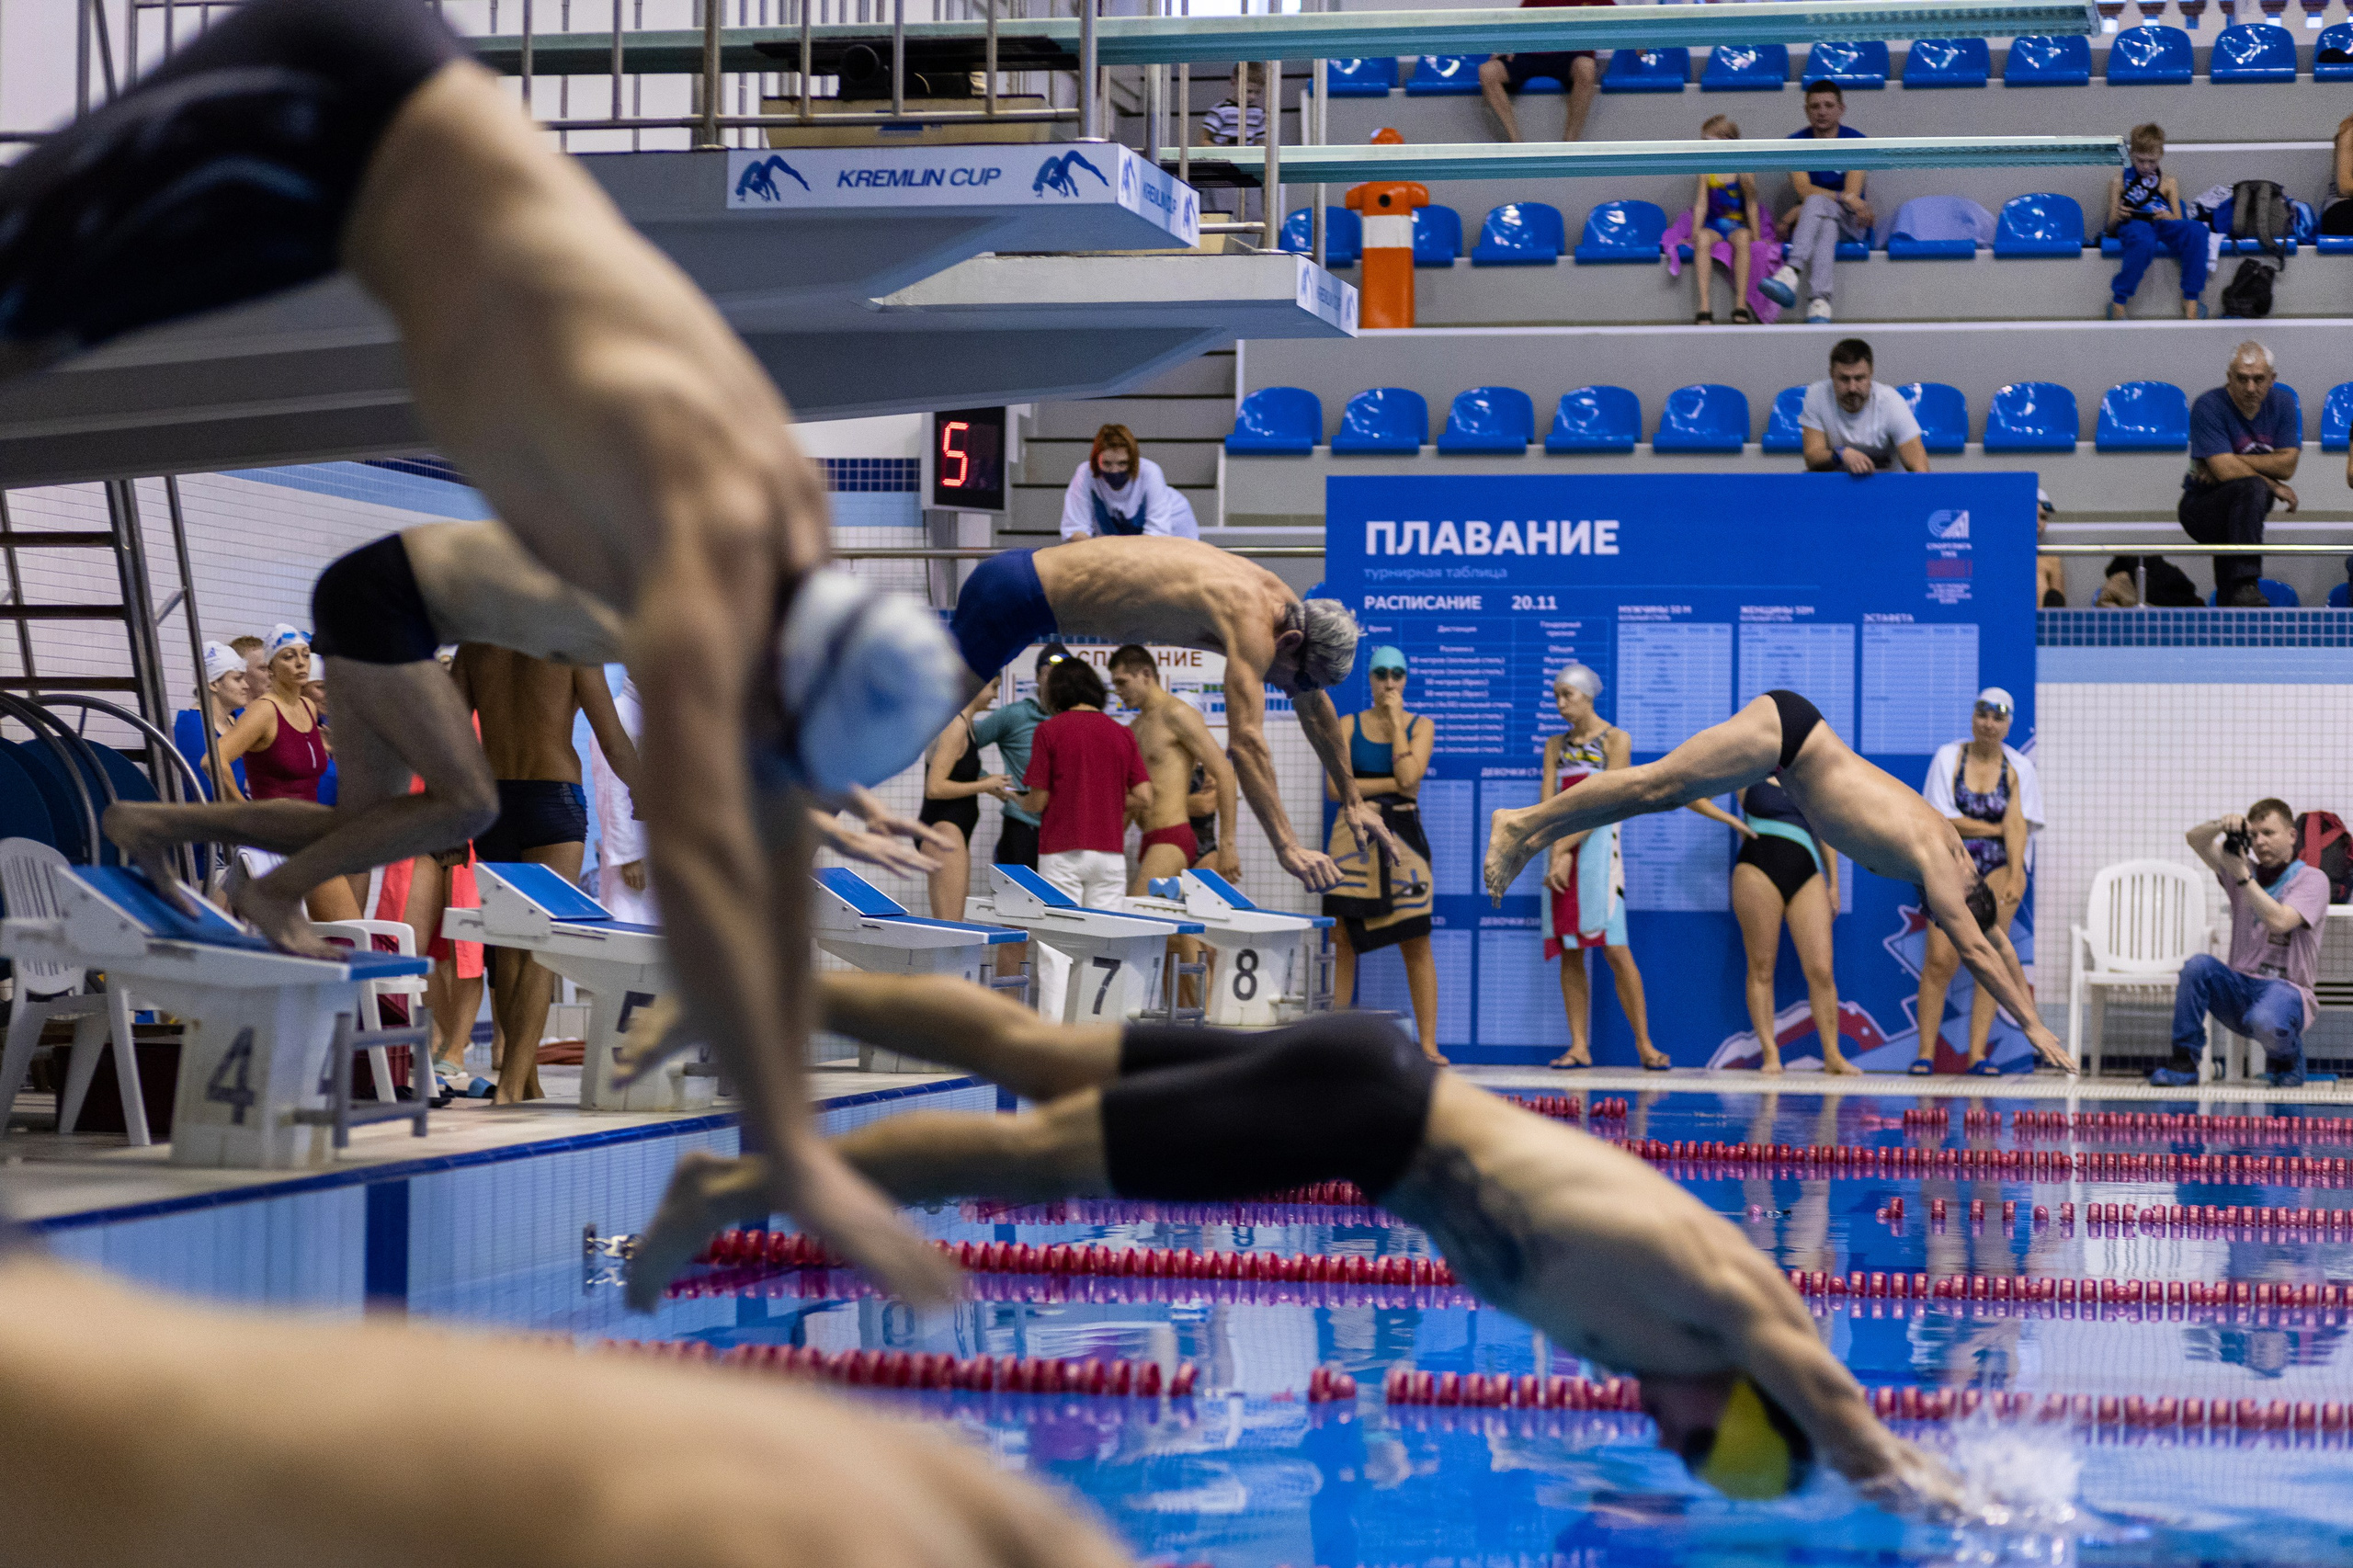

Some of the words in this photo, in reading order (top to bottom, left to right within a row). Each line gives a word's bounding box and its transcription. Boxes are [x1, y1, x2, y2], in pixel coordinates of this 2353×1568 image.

[836, 168, 946, 187] KREMLIN
[949, 167, 1002, 186] CUP
[942, 421, 970, 487] 5
[1365, 520, 1620, 556] ПЛАВАНИЕ
[1364, 568, 1442, 581] турнирная
[1446, 564, 1508, 580] таблица
[1364, 596, 1483, 610] РАСПИСАНИЕ
[1511, 596, 1558, 610] 20.11
[1092, 956, 1121, 1015] 7
[1233, 949, 1259, 1001] 8
[206, 1027, 256, 1126] 4
